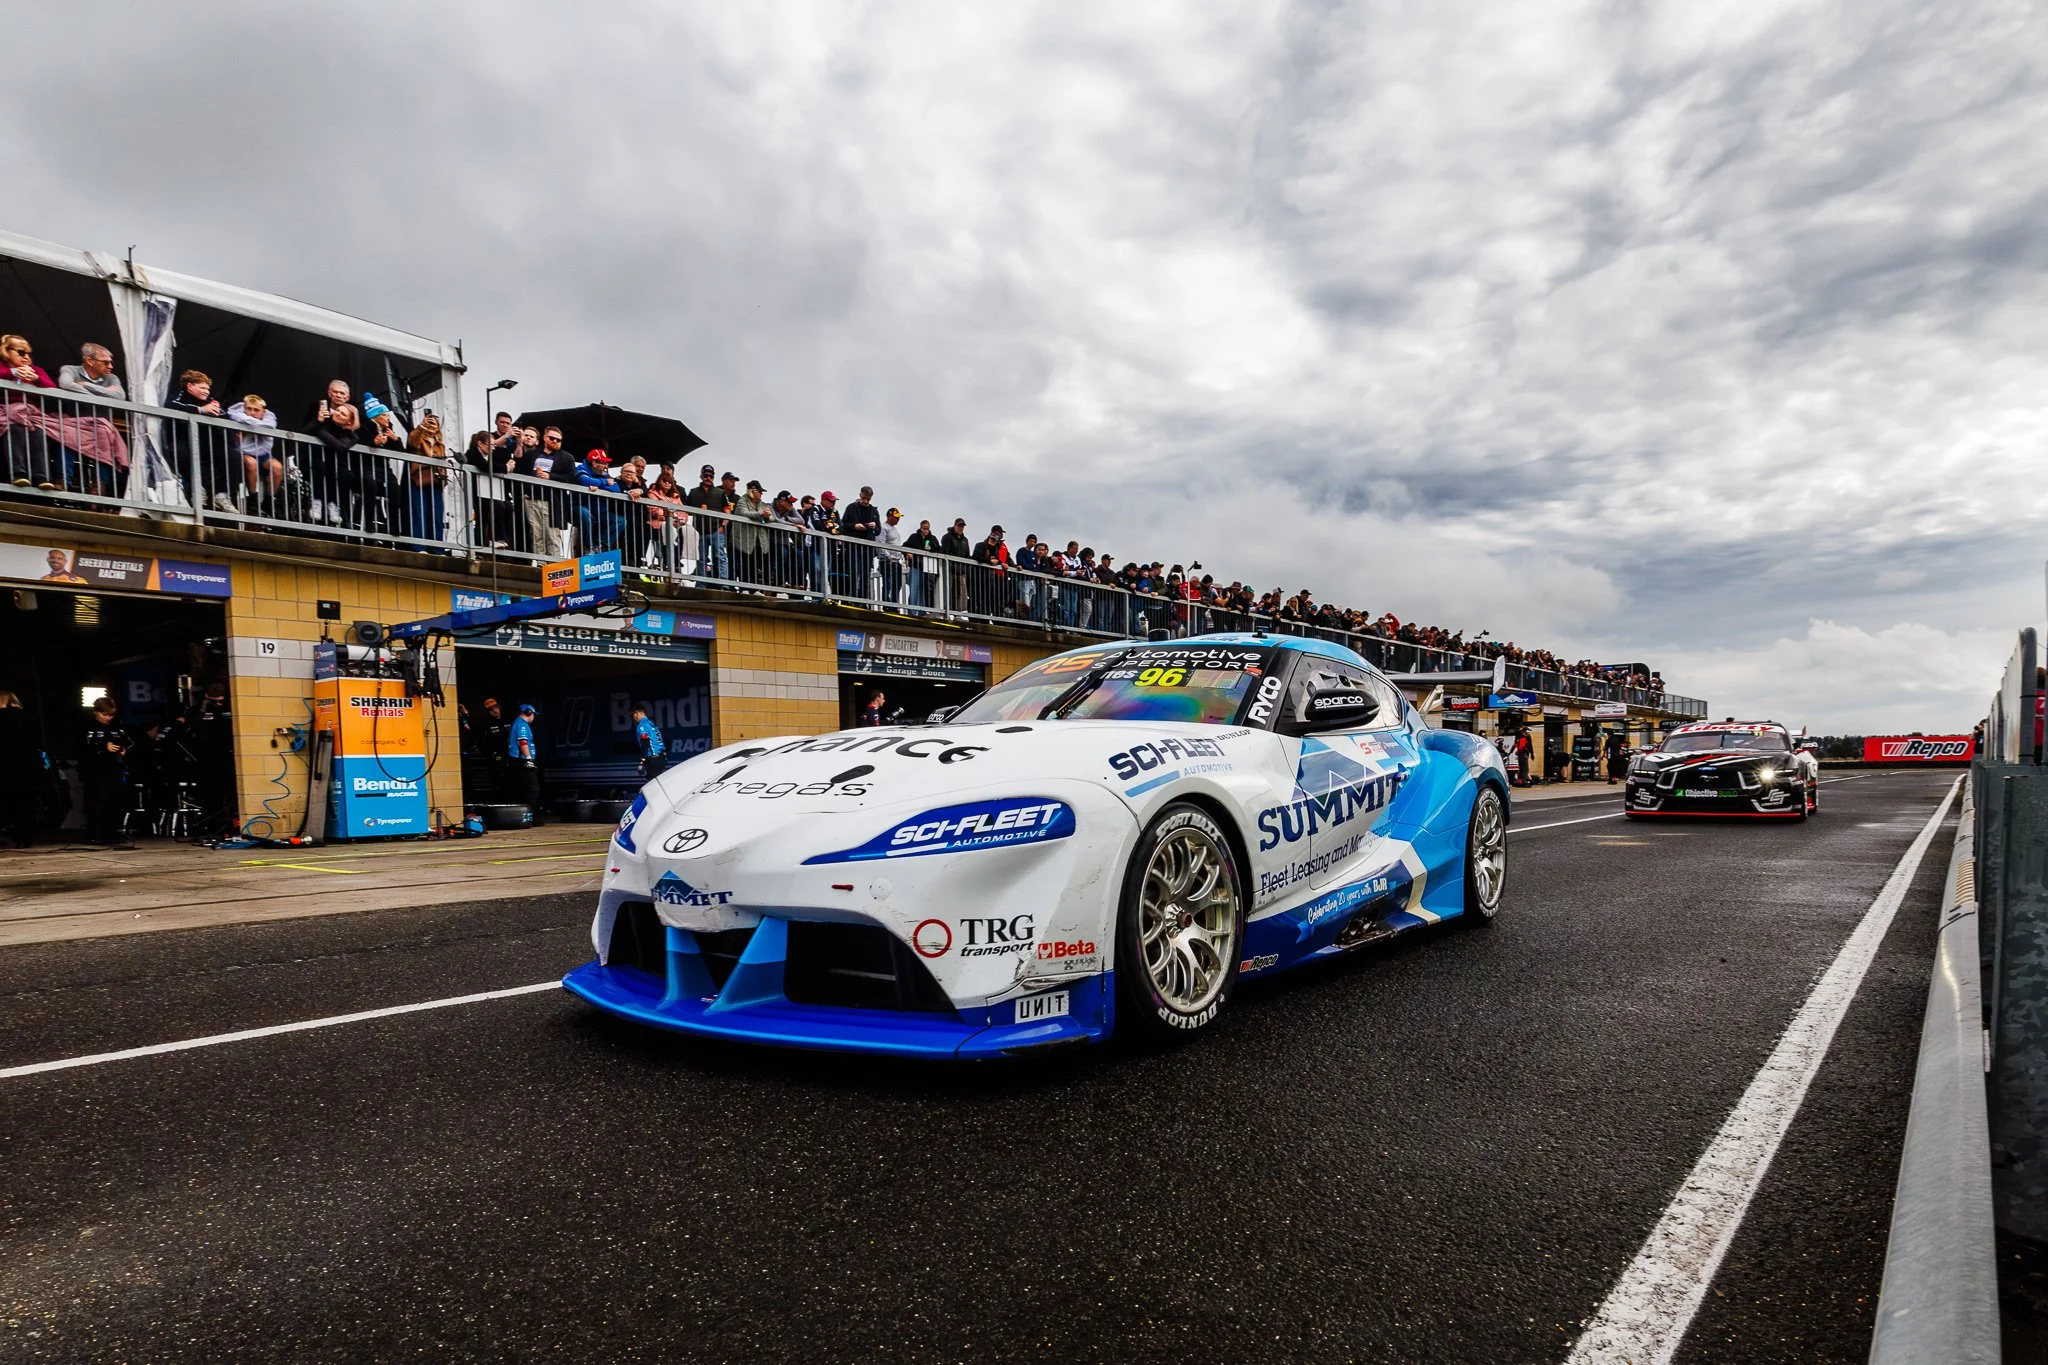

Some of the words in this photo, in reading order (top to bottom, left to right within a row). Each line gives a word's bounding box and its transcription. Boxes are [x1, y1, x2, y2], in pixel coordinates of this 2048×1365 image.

[112, 560, 144, 573] RENTALS
[584, 560, 615, 576] Bendix
[98, 568, 126, 580] RACING
[175, 571, 227, 583] Tyrepower
[547, 568, 574, 581] SHERRIN
[567, 594, 595, 607] Tyrepower
[687, 621, 713, 630] Tyrepower
[261, 642, 275, 654] 19
[548, 640, 599, 653] Garage
[608, 644, 648, 656] Doors
[869, 637, 875, 649] 8
[886, 666, 917, 677] Garage
[922, 669, 946, 677] Doors
[1134, 668, 1187, 687] 96
[351, 697, 413, 708] SHERRIN
[1247, 676, 1283, 725] RYCO
[1314, 696, 1365, 709] sparco
[361, 707, 404, 717] Rentals
[1216, 729, 1251, 740] DUNLOP
[1680, 725, 1773, 733] Liberty
[1903, 739, 1968, 759] Repco
[1108, 738, 1225, 780] SCI-FLEET
[1184, 764, 1233, 776] AUTOMOTIVE
[353, 778, 418, 791] Bendix
[1685, 789, 1718, 797] Objective
[1258, 774, 1399, 852] SUMMIT
[376, 817, 412, 826] Tyrepower
[890, 803, 1062, 845] SCI-FLEET
[952, 829, 1047, 847] AUTOMOTIVE
[1261, 865, 1289, 896] Fleet
[1291, 851, 1331, 883] Leasing
[1331, 838, 1350, 864] and
[1308, 899, 1338, 925] Celebrating
[1337, 891, 1346, 906] 20
[1347, 889, 1361, 905] years
[1373, 877, 1388, 893] BJR
[959, 914, 1036, 945] TRG
[960, 940, 1035, 957] transport
[1054, 940, 1095, 958] Beta
[1252, 954, 1279, 971] Repco
[1020, 994, 1065, 1019] UNIT
[1157, 1001, 1218, 1030] DUNLOP
